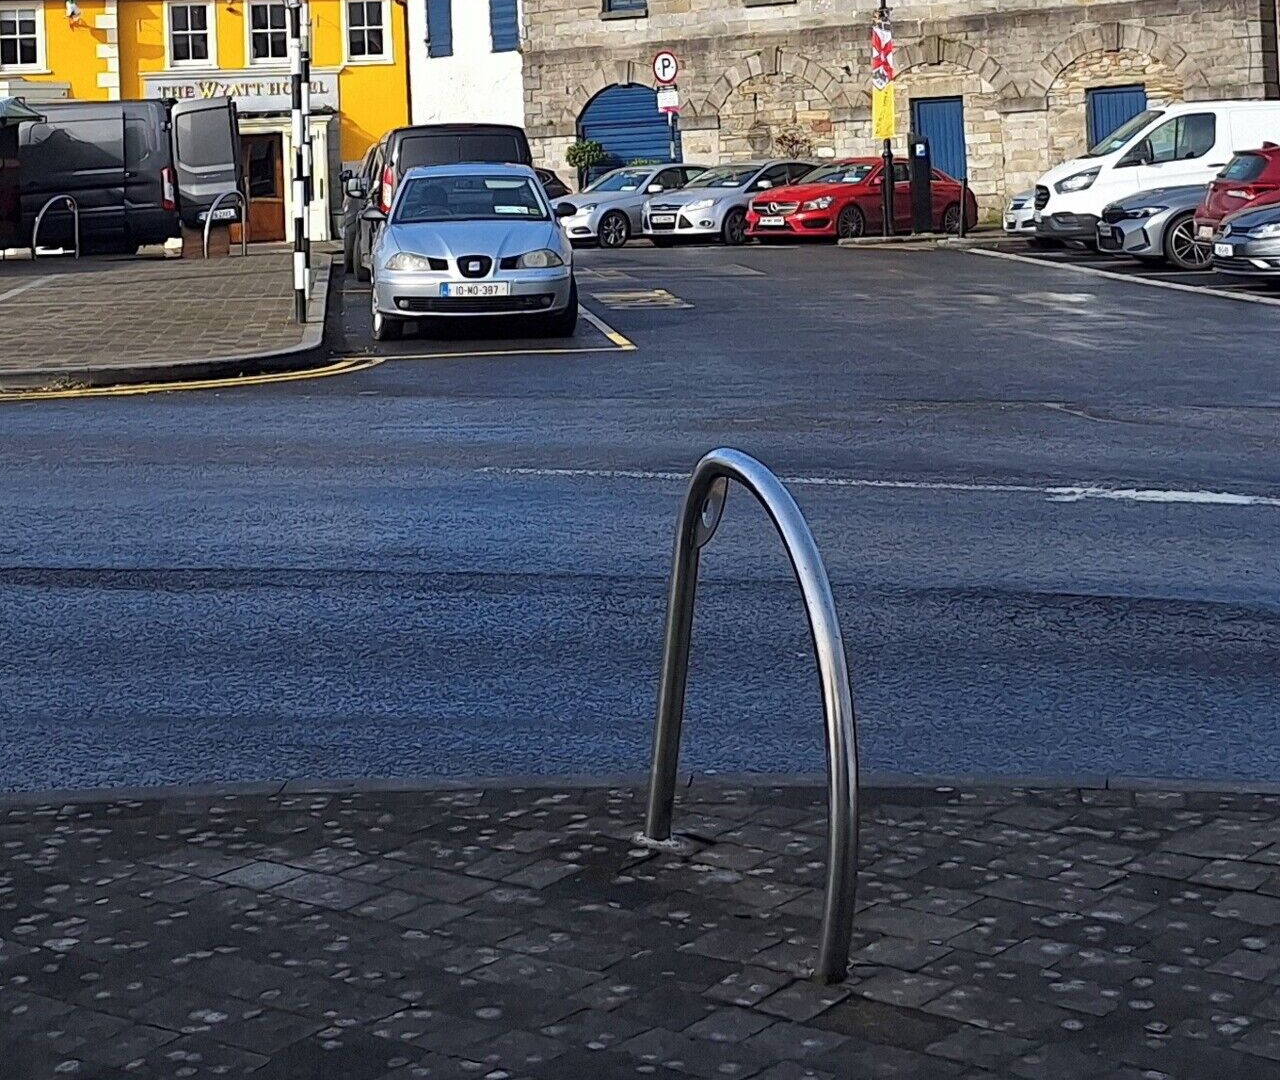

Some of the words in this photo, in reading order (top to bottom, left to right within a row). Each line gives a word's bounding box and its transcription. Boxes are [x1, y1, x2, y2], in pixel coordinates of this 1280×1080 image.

[662, 58, 671, 77] P
[157, 85, 195, 99] THE
[195, 80, 265, 99] WYATT
